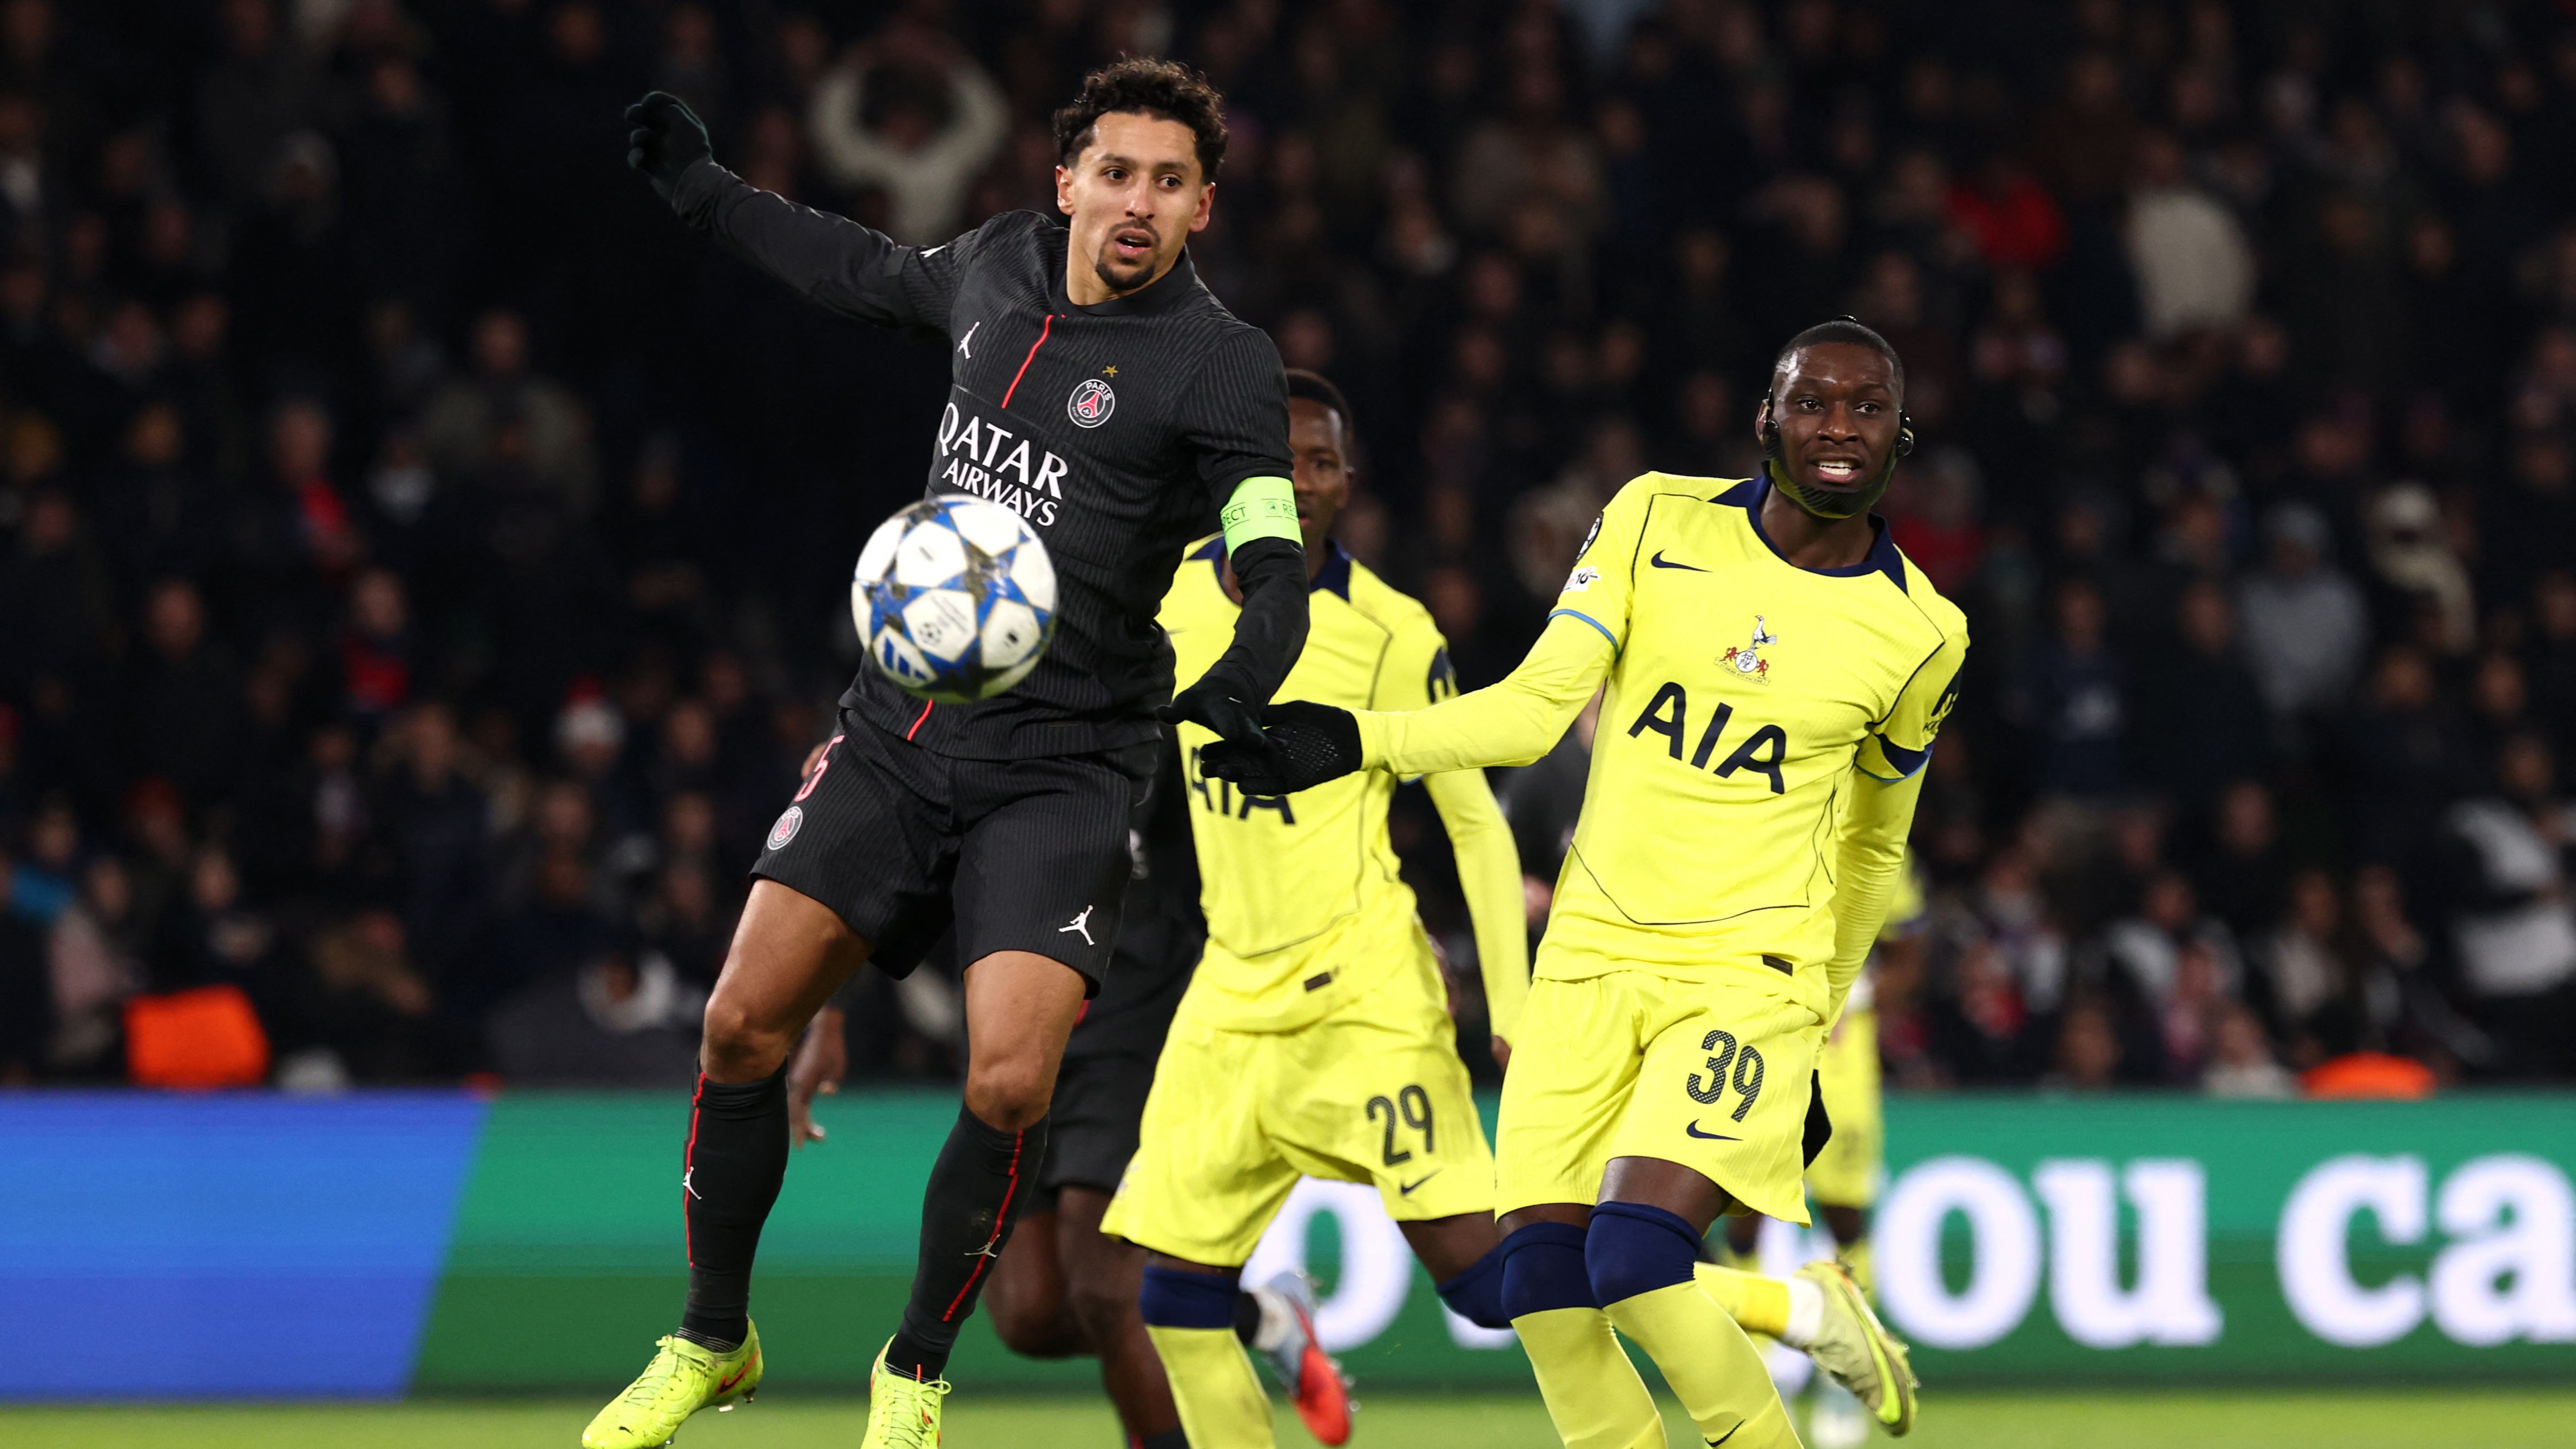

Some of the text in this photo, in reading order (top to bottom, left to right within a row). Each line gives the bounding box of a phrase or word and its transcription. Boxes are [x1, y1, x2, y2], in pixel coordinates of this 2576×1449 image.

[1086, 382, 1111, 400] PARIS
[939, 402, 1068, 500] QATAR
[941, 458, 1058, 526] AIRWAYS
[794, 735, 845, 802] 5
[1627, 682, 1786, 794] AIA
[1685, 1030, 1764, 1123] 39
[1366, 1084, 1435, 1167] 29
[2279, 1152, 2576, 1348] ca
